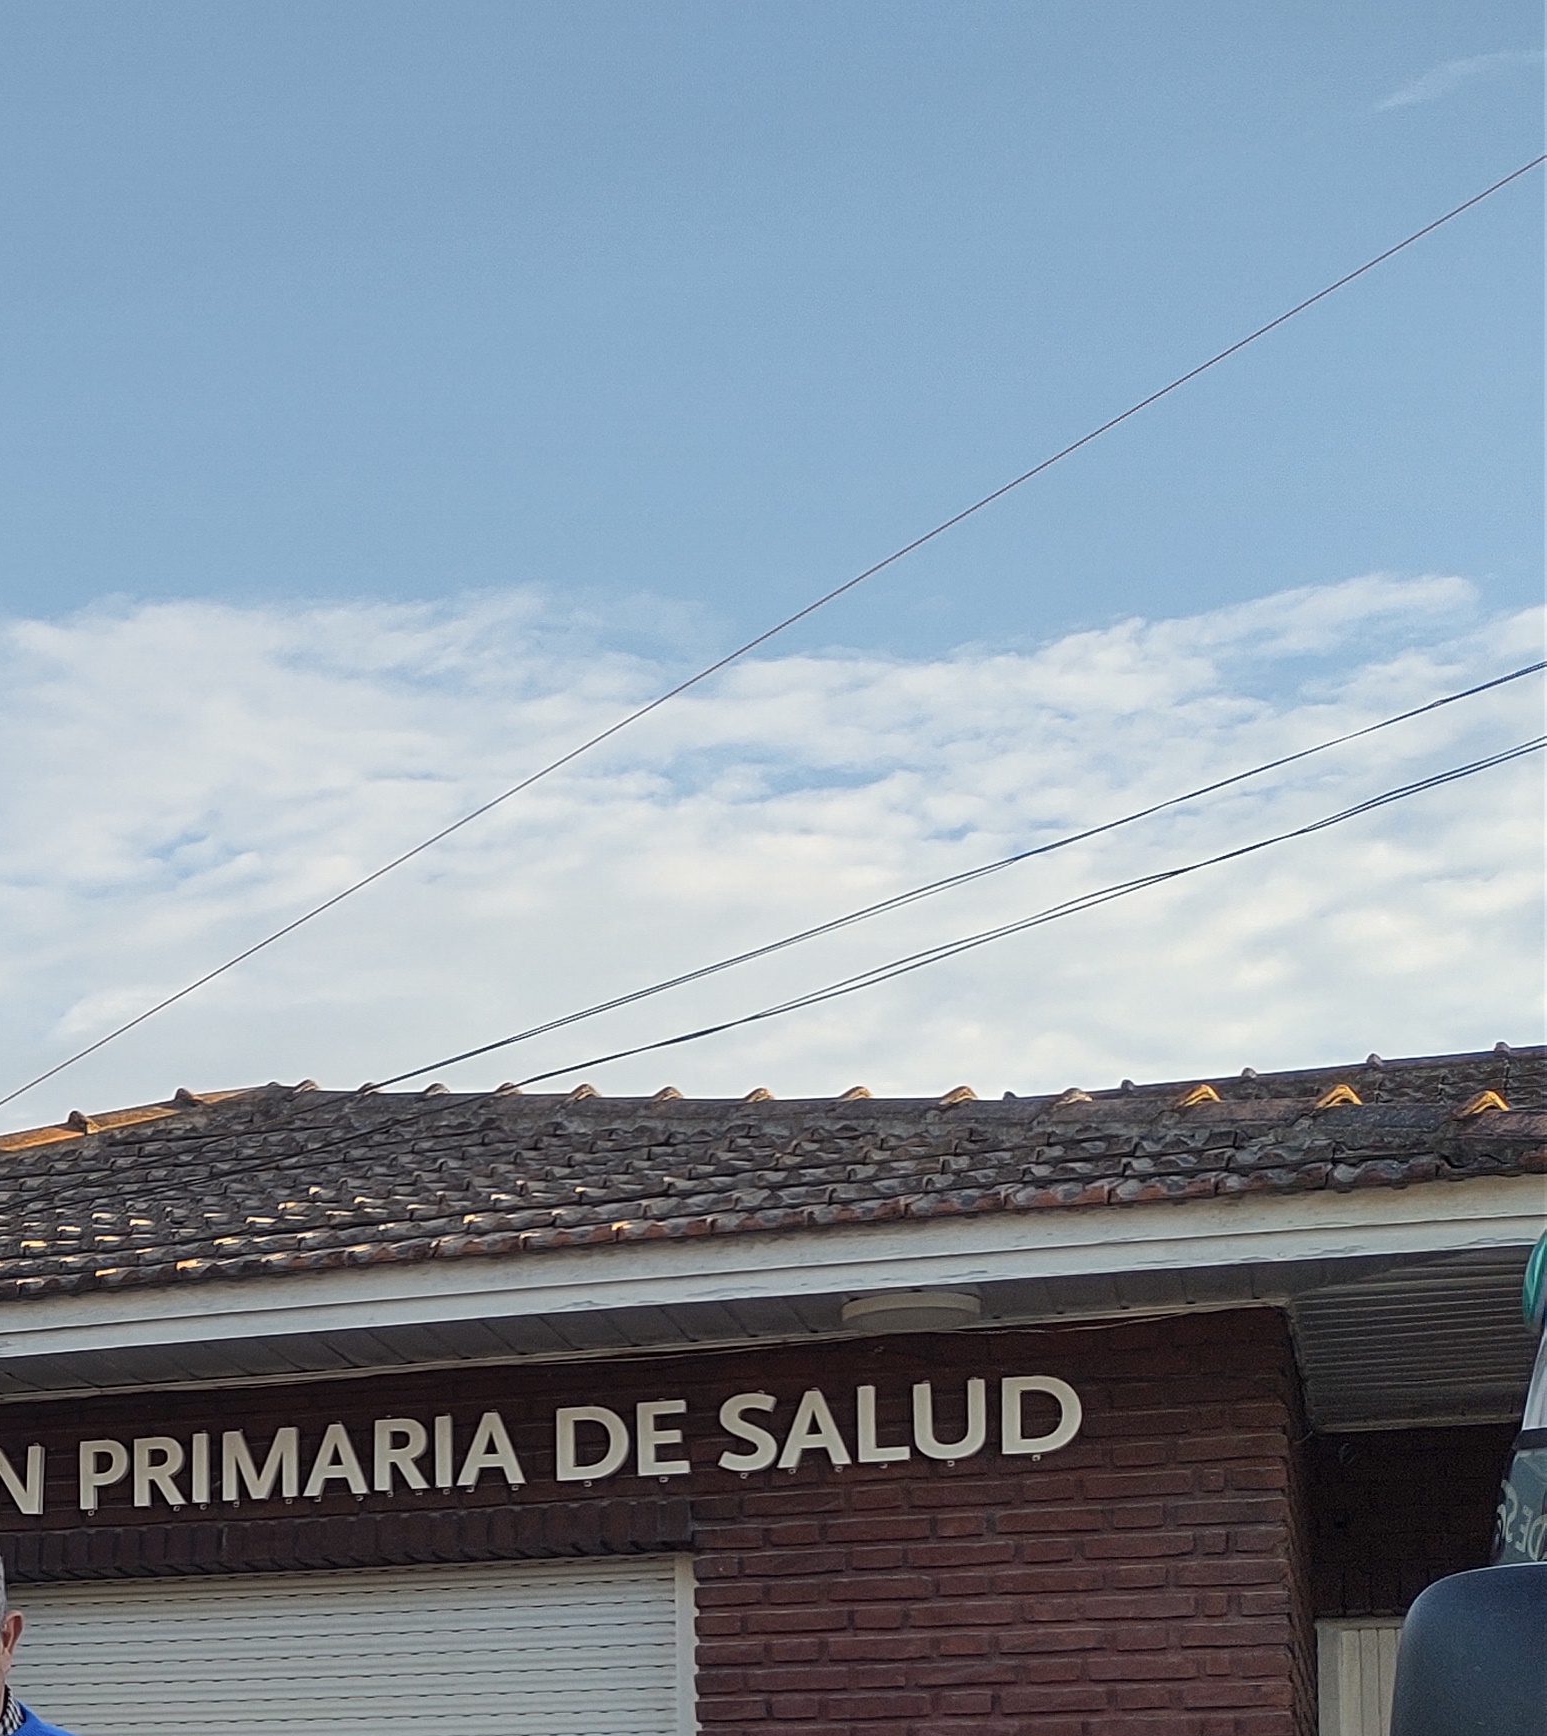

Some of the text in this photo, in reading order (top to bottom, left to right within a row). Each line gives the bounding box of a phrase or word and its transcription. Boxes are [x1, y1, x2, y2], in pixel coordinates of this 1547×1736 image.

[80, 1411, 525, 1510] PRIMARIA
[555, 1400, 689, 1482] DE
[718, 1376, 1082, 1473] SALUD
